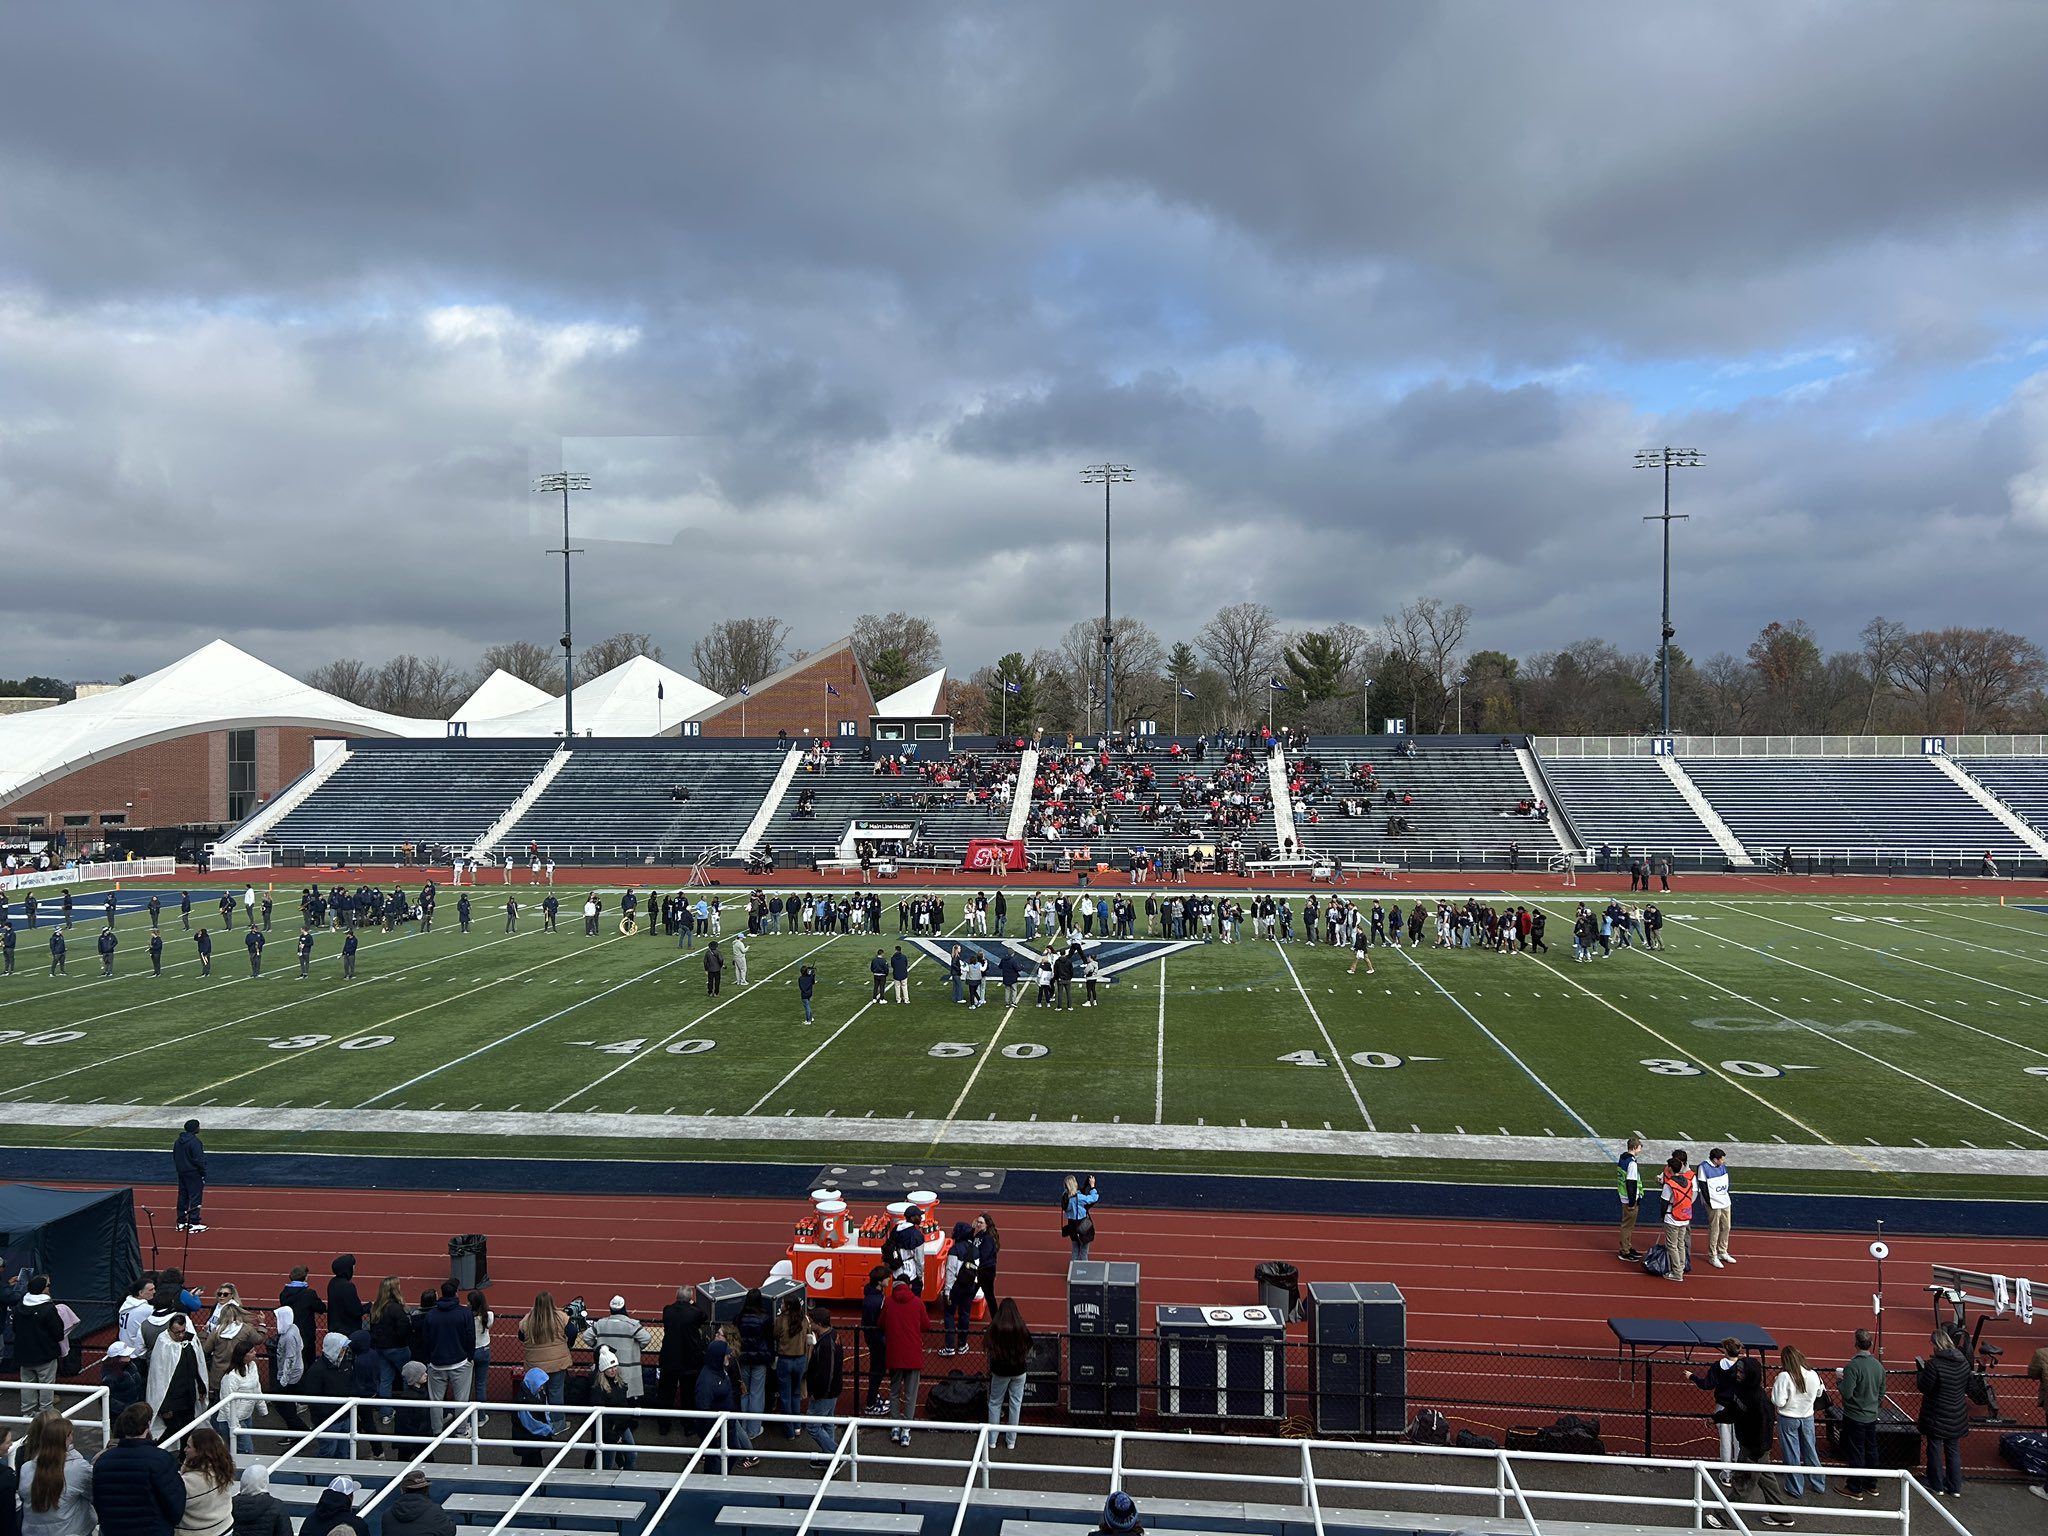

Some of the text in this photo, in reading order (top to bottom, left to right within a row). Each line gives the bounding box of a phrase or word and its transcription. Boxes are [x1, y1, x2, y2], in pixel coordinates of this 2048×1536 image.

[448, 722, 466, 737] NA
[684, 722, 700, 736] NB
[840, 722, 855, 736] NC
[1140, 721, 1156, 735] ND
[1387, 719, 1404, 734] NE
[823, 1218, 834, 1231] G
[805, 1259, 832, 1290] G
[1073, 1303, 1100, 1316] VILLANOVA
